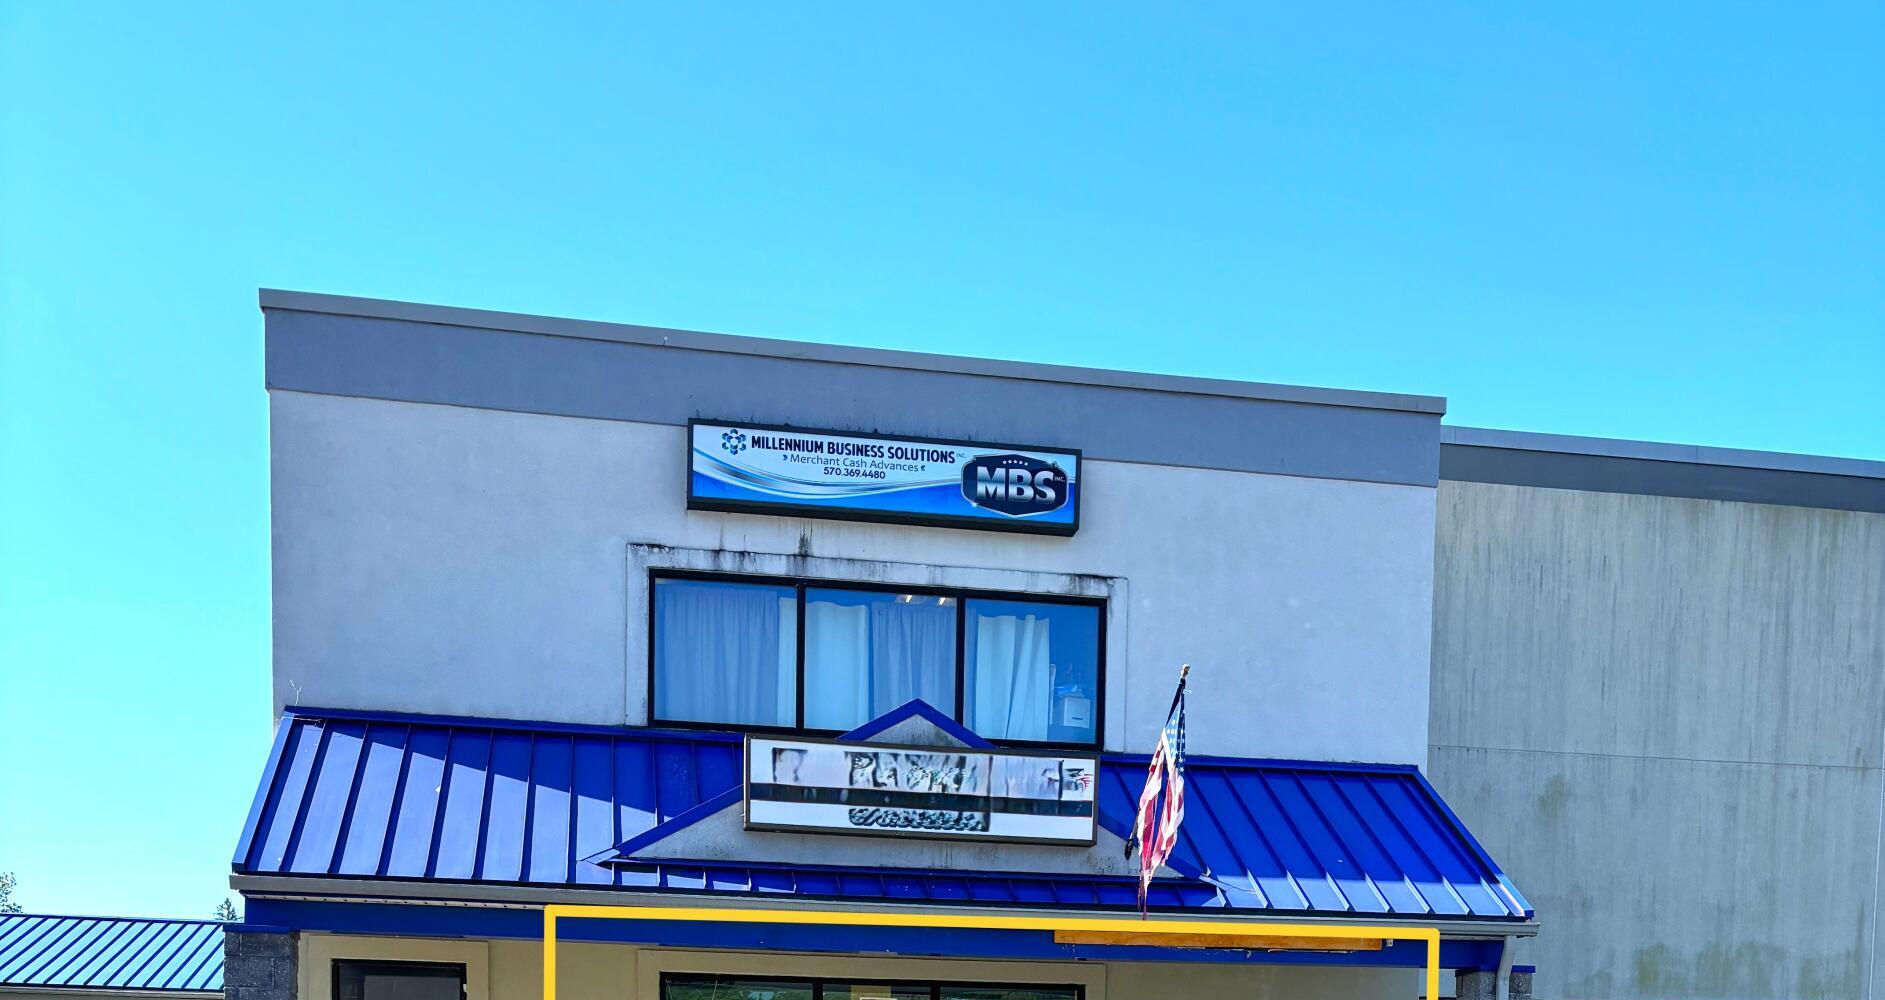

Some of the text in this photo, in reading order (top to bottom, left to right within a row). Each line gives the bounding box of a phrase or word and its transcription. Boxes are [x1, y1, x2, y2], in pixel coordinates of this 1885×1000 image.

[751, 435, 824, 454] MILLENNIUM
[827, 441, 885, 459] BUSINESS
[887, 446, 956, 464] SOLUTIONS
[790, 454, 919, 472] Merchant Cash Advances
[823, 466, 886, 479] 570.369.4480
[977, 466, 1056, 505] MBS
